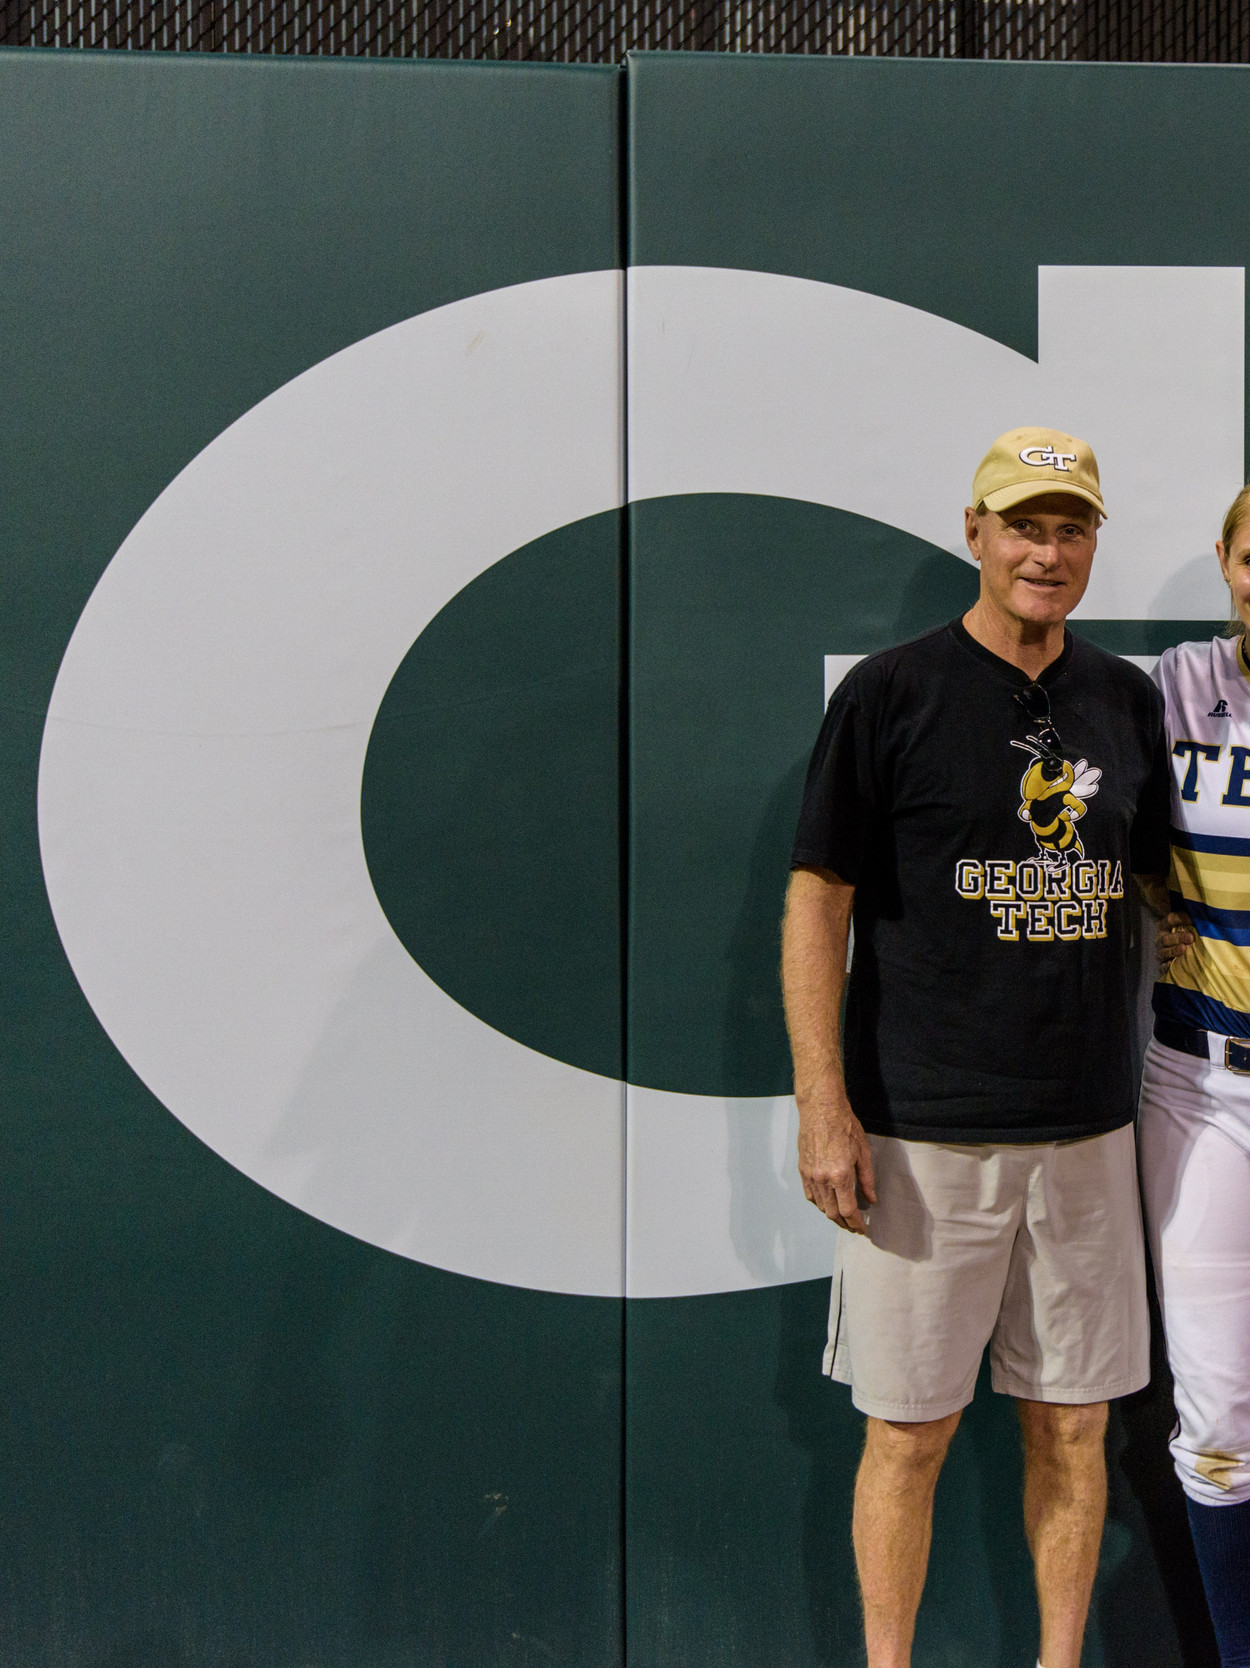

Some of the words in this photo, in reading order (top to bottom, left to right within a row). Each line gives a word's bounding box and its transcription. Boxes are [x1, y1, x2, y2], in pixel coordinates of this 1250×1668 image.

[1018, 445, 1077, 472] GT
[955, 859, 1124, 900] GEORGIA
[990, 899, 1108, 942] TECH
